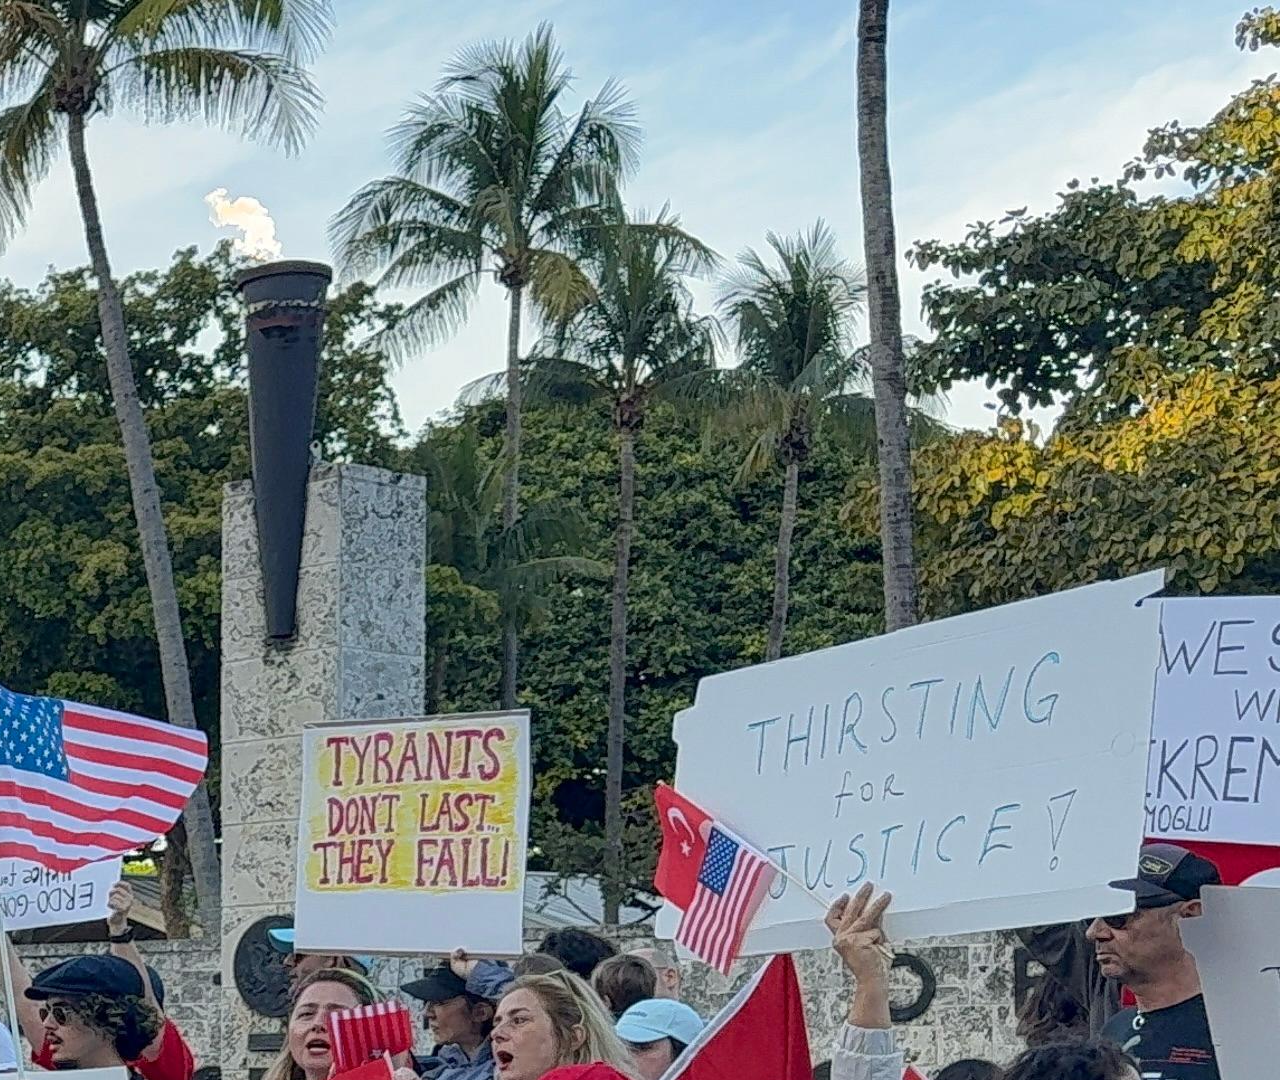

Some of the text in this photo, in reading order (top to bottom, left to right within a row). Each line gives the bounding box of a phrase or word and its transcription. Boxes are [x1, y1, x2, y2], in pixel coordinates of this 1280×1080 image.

[1160, 620, 1255, 675] WE
[747, 651, 1061, 776] THIRSTING
[326, 728, 505, 786] TYRANTS
[1146, 735, 1280, 803] KREM
[327, 792, 400, 836] DON'T
[313, 838, 509, 887] THEY FALL!
